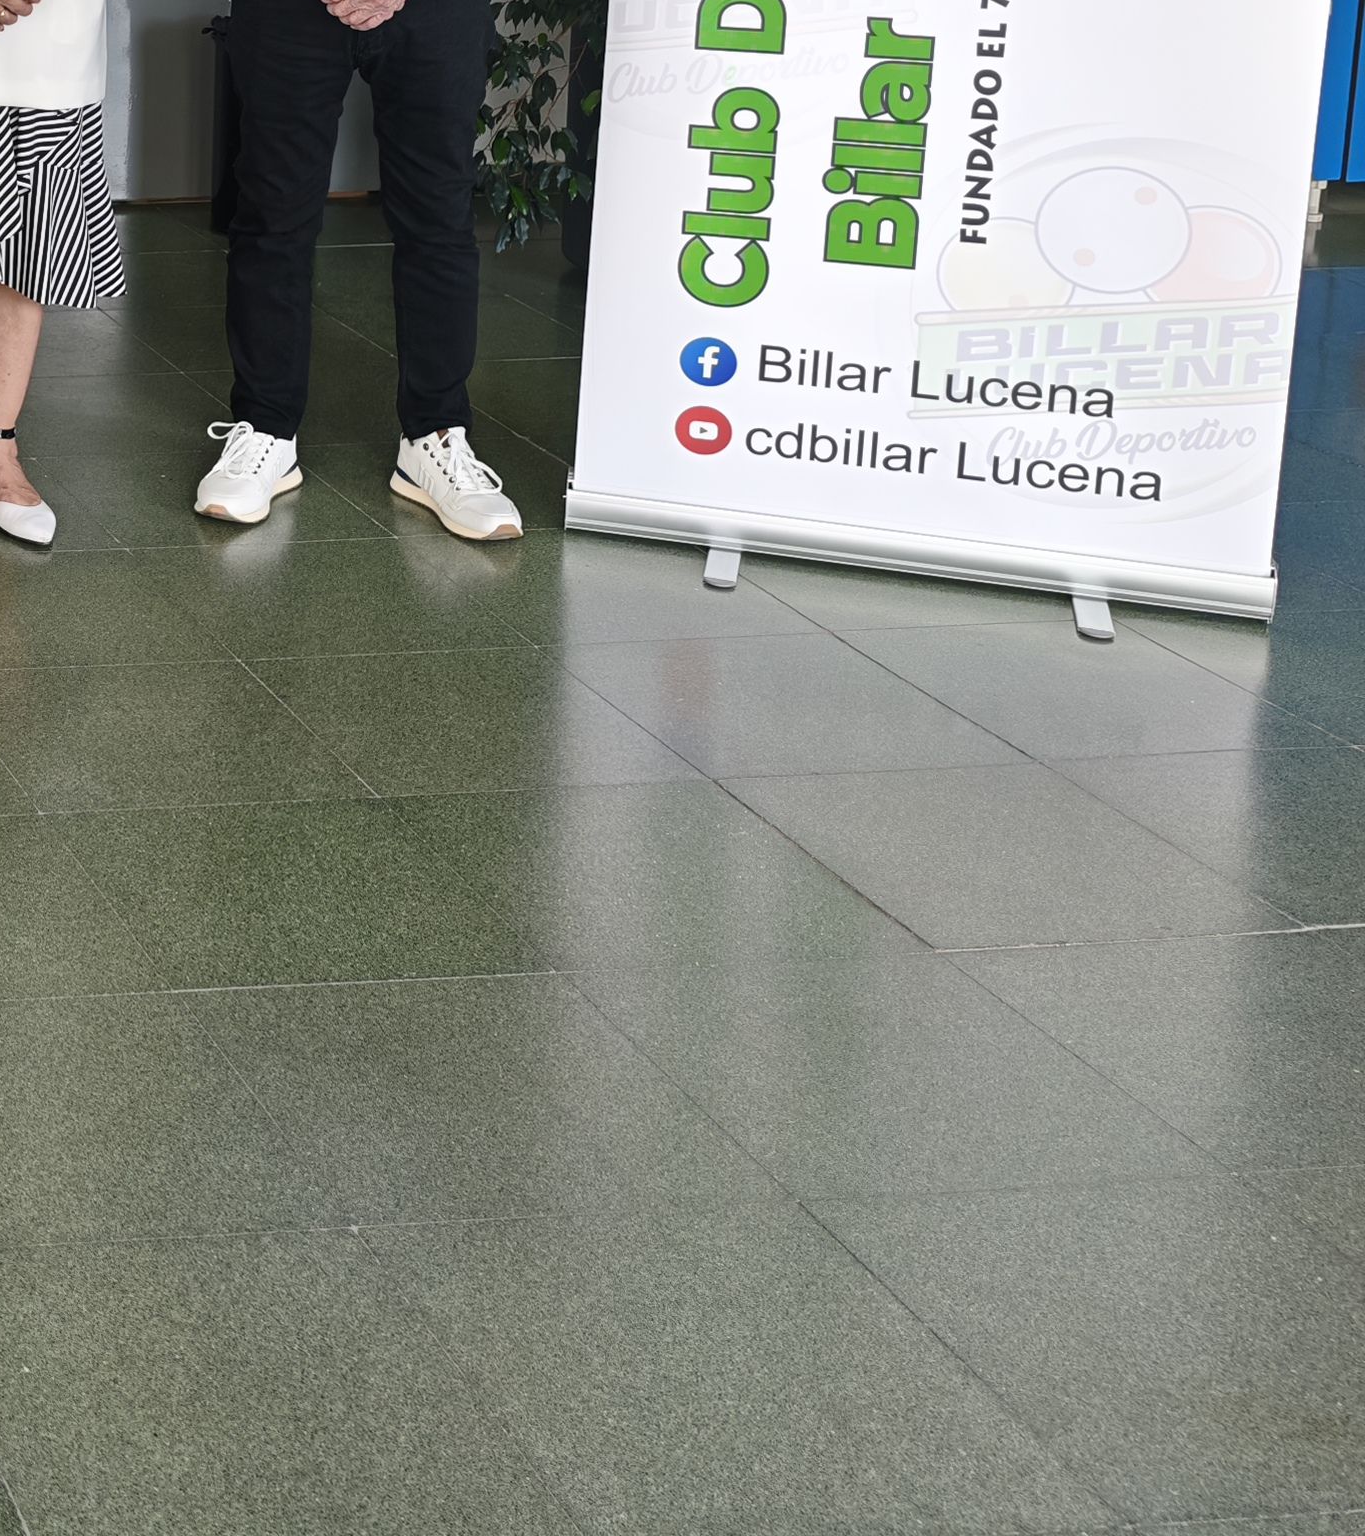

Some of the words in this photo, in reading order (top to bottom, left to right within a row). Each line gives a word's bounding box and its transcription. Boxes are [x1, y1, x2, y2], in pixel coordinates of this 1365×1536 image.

[976, 23, 1007, 58] EL
[823, 16, 935, 270] Billar
[959, 69, 1003, 245] FUNDADO
[678, 86, 780, 308] Club
[956, 312, 1280, 362] BILLAR
[757, 344, 891, 394] Billar
[910, 359, 1116, 418] Lucena
[744, 422, 938, 475] cdbillar
[956, 441, 1163, 502] Lucena
[986, 425, 1067, 467] Club
[1076, 417, 1257, 466] Deportivo
